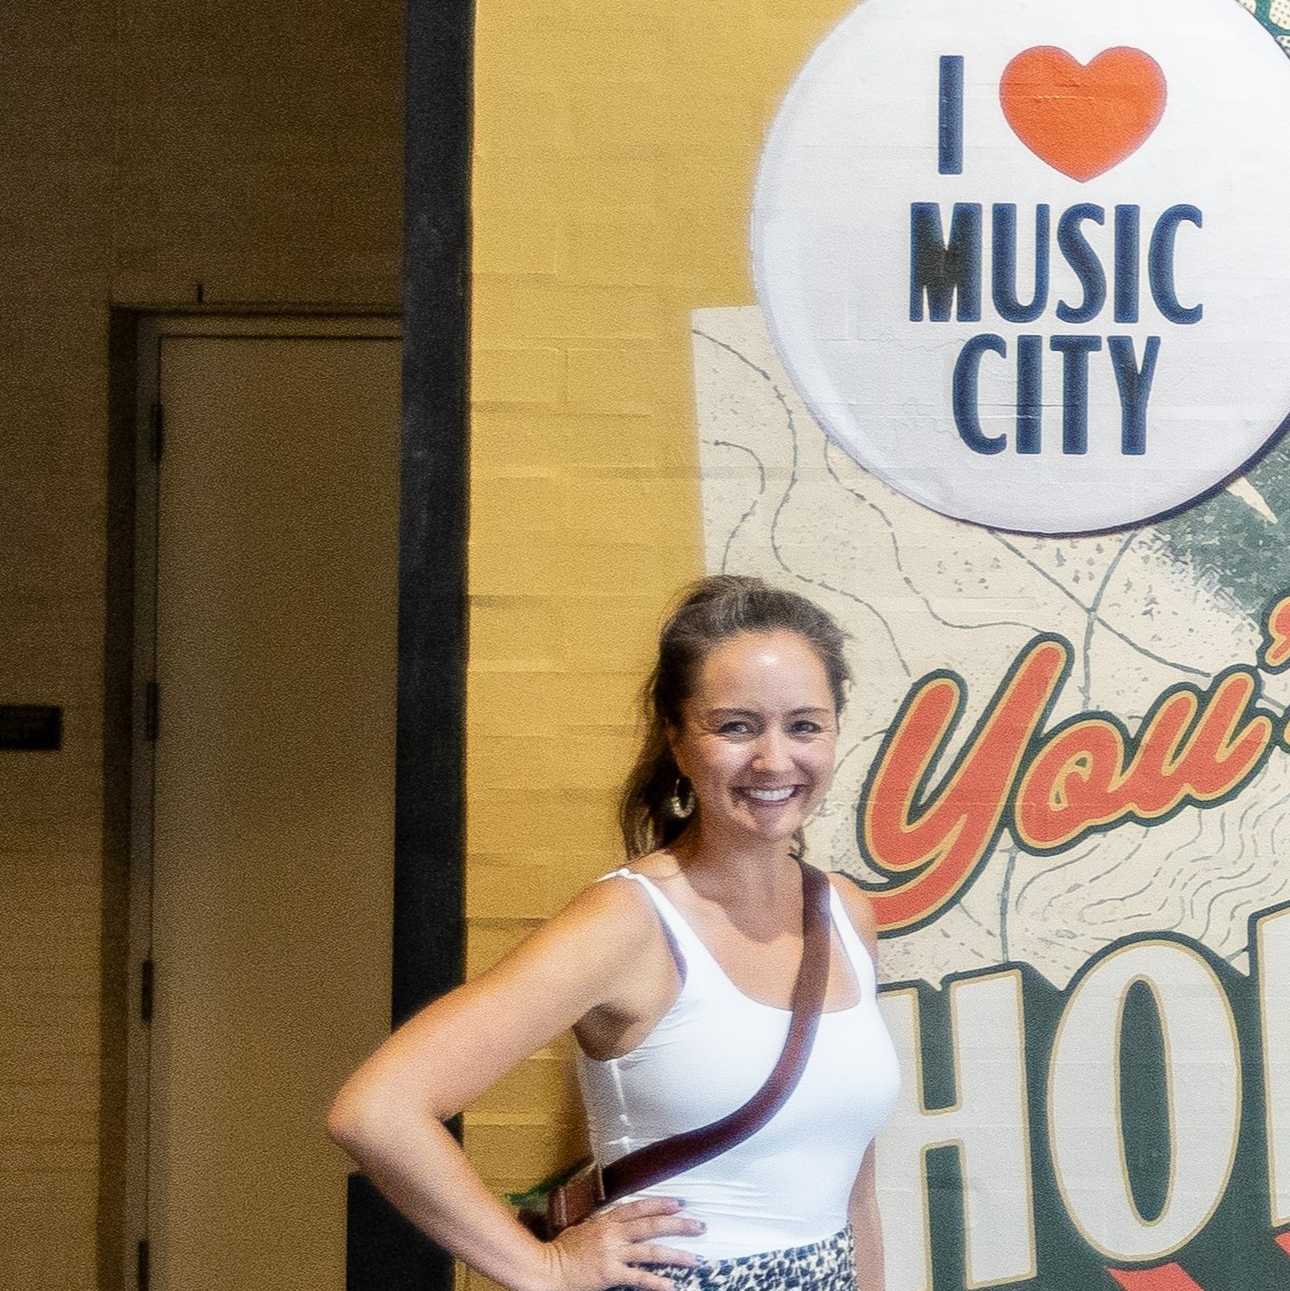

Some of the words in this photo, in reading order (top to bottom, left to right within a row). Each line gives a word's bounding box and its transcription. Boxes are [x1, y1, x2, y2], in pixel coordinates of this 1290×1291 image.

[938, 54, 964, 175] I
[908, 202, 1204, 325] MUSIC
[951, 332, 1162, 456] CITY
